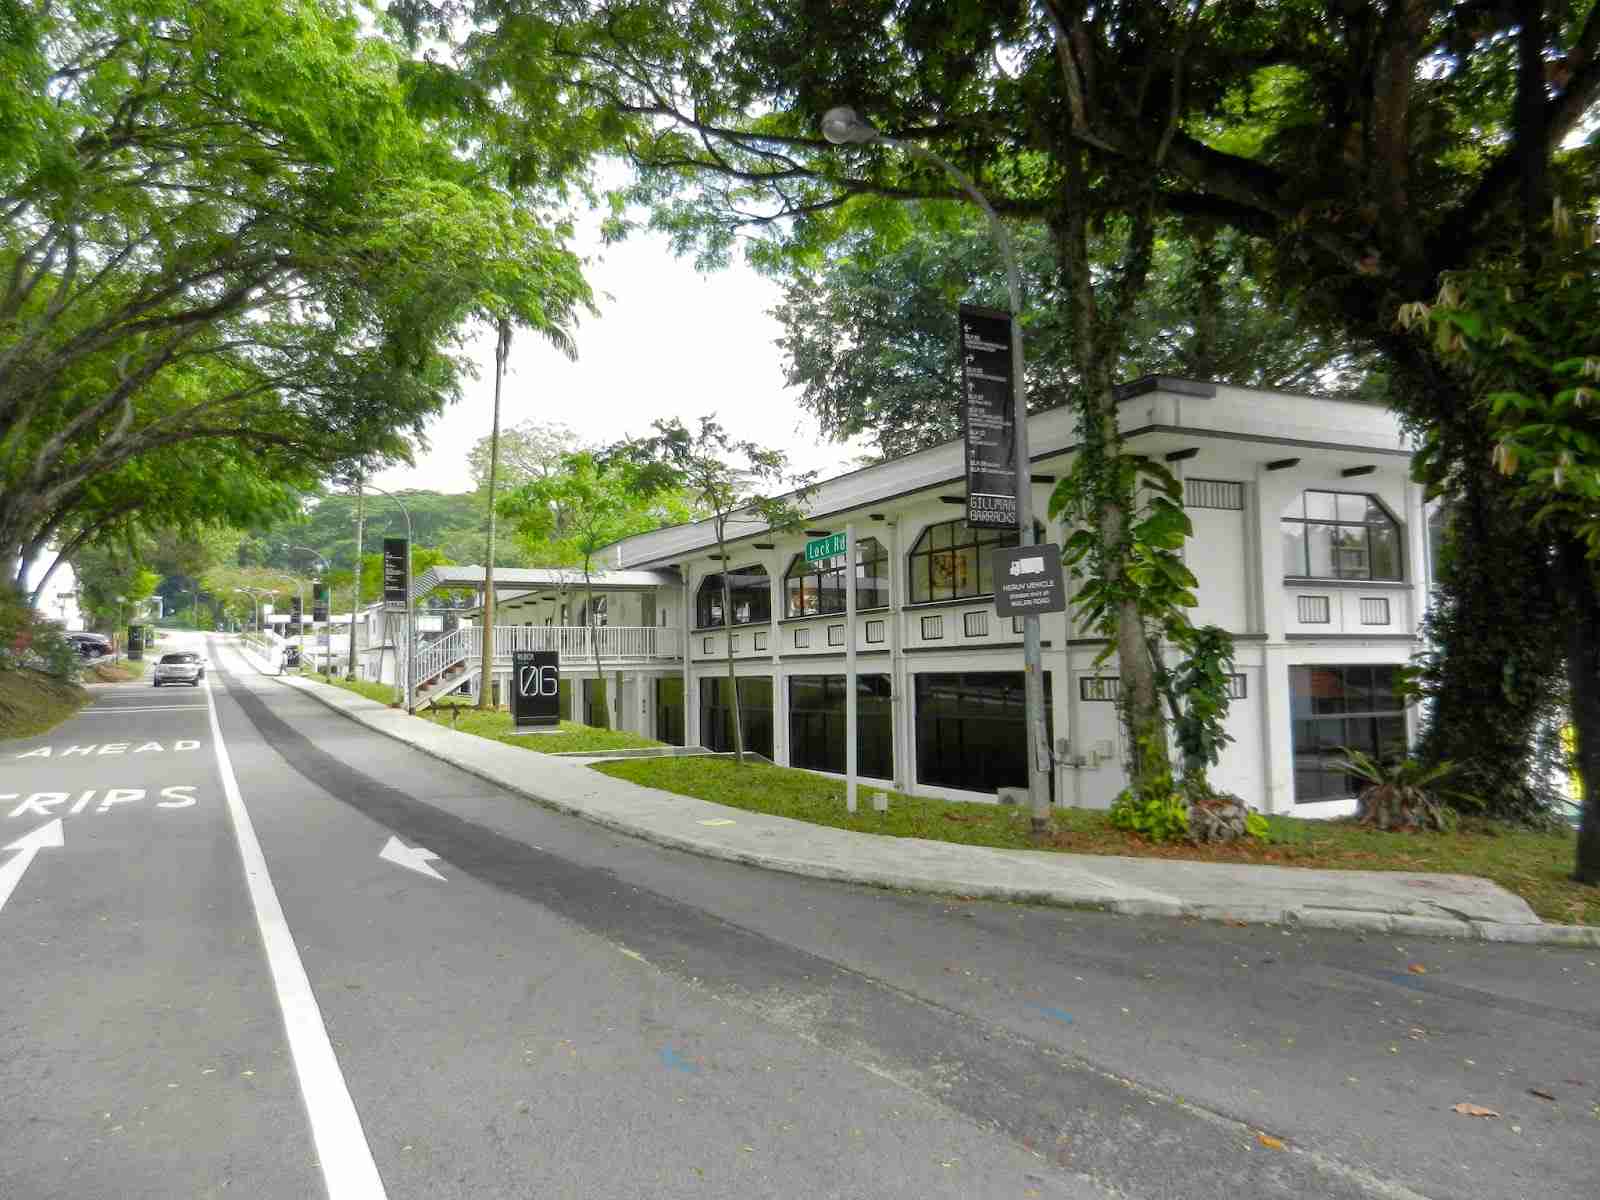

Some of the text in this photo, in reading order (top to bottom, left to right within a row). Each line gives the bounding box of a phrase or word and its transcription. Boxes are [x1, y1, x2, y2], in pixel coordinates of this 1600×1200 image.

[970, 496, 1016, 513] GILLMAN
[970, 509, 1016, 524] BARRACKS
[809, 540, 830, 559] Lock
[1026, 580, 1056, 590] VEHICLE
[520, 665, 558, 696] 06
[16, 740, 200, 759] AHEAD
